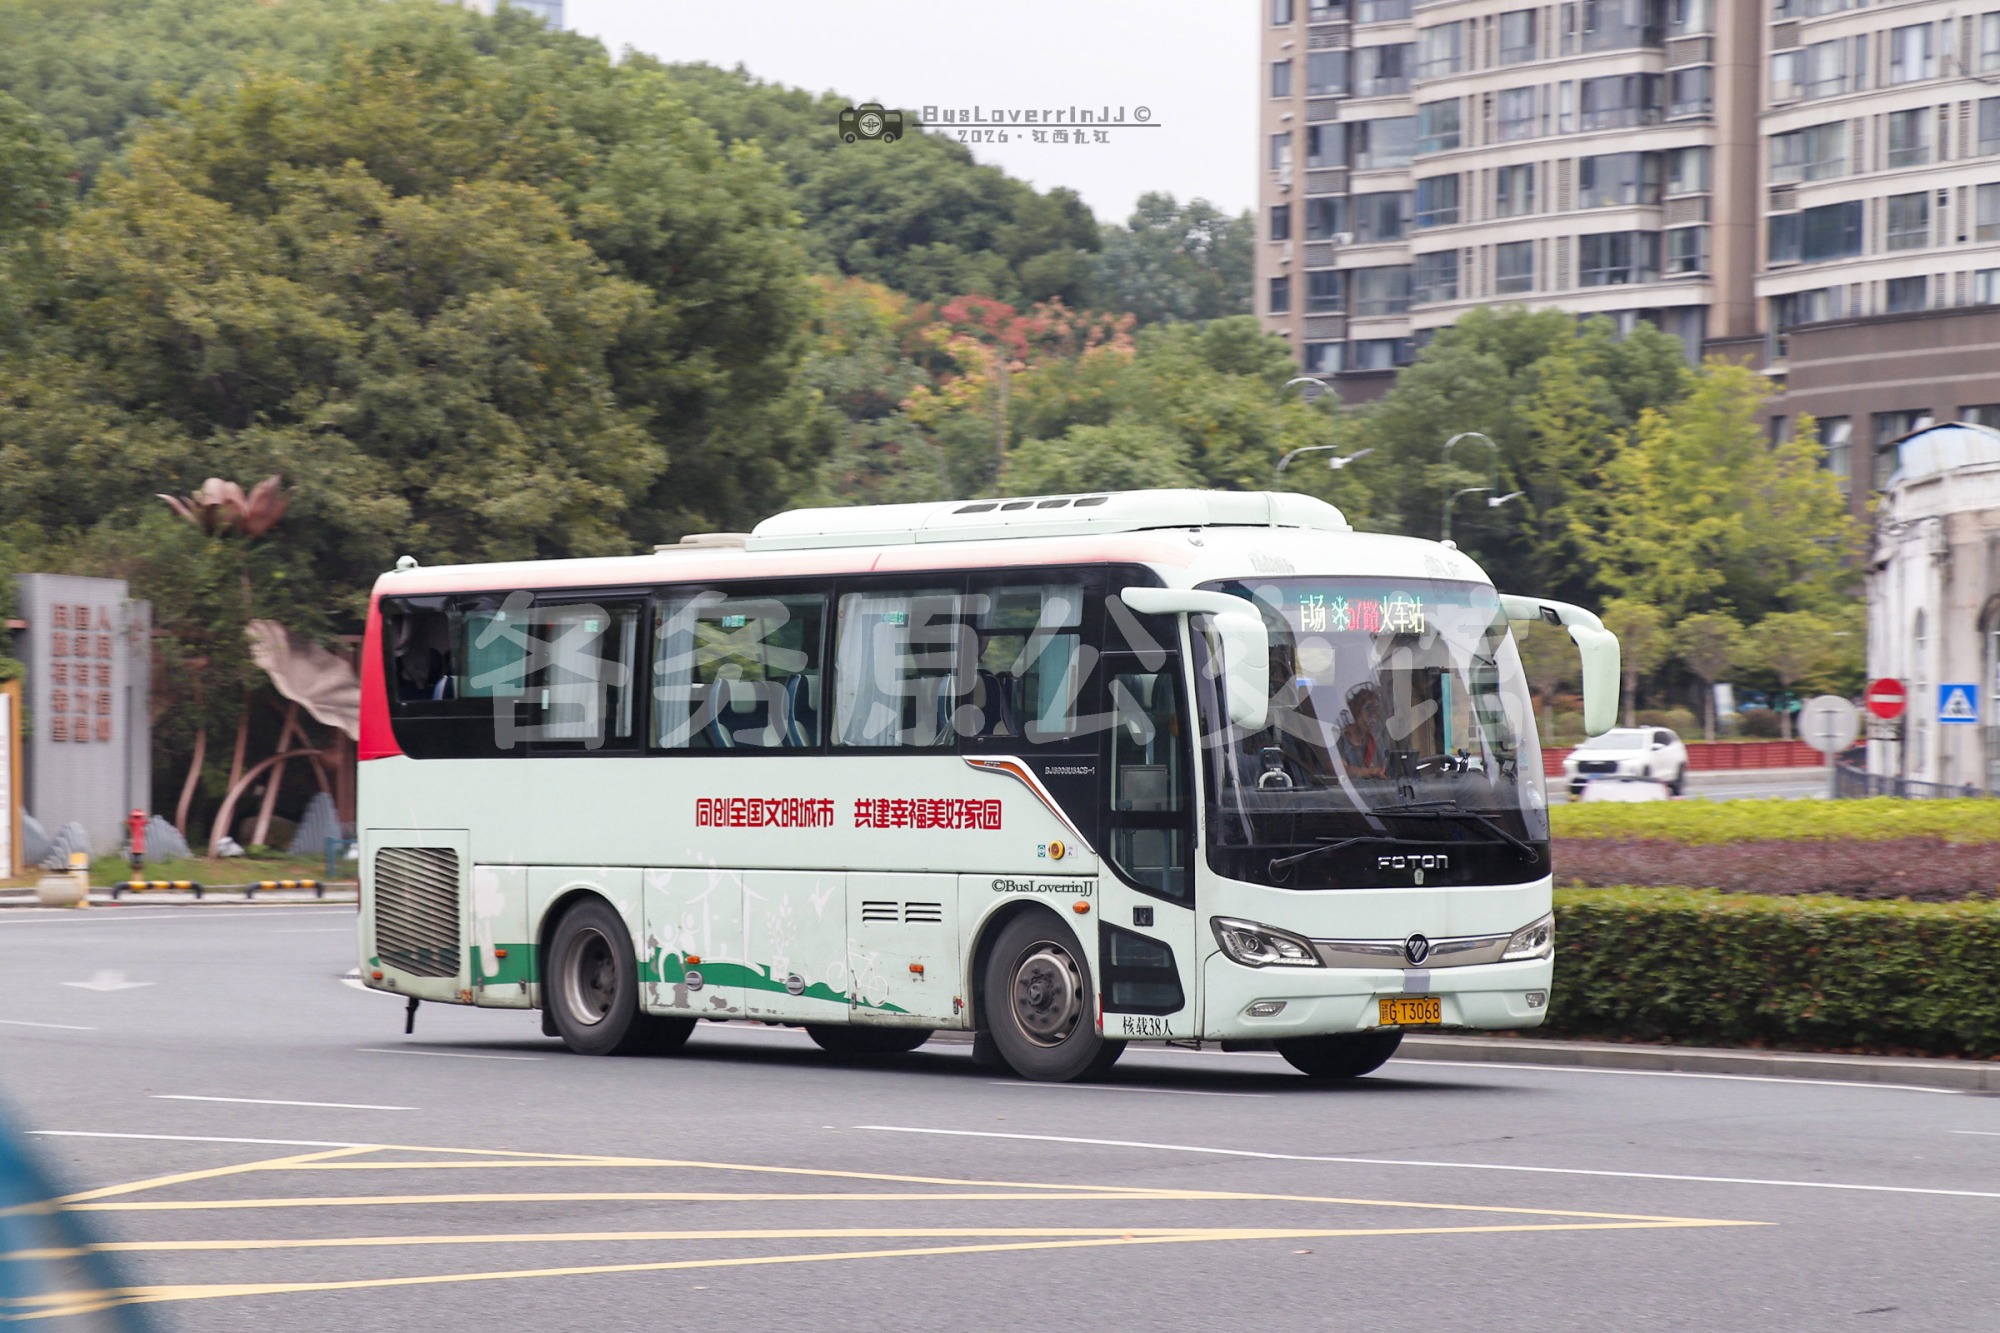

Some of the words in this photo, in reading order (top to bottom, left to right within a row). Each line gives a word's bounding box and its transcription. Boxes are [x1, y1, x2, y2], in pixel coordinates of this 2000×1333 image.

[696, 798, 835, 828] 同创全国文明城市
[854, 798, 1002, 830] 共建幸福美好家园
[1378, 854, 1449, 869] FOTON
[1122, 1015, 1174, 1037] 核载38人
